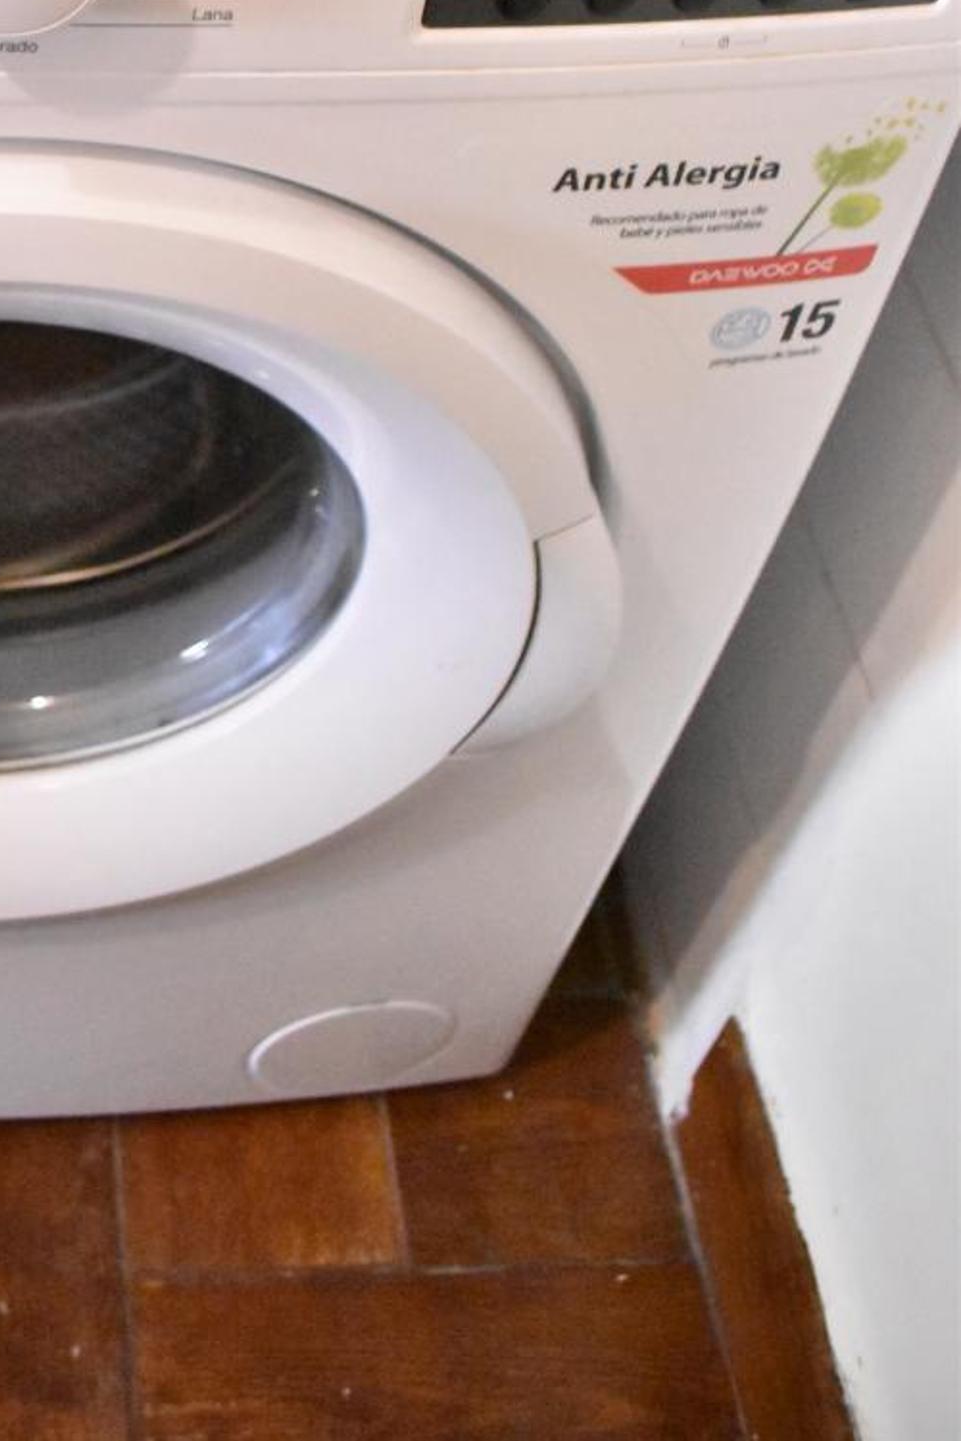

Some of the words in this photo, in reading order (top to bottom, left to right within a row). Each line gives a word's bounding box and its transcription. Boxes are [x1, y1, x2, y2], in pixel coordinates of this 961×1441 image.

[191, 6, 234, 22] Lana
[552, 163, 637, 194] Anti
[643, 155, 782, 192] Alergia
[690, 260, 799, 286] DAEWOO
[779, 298, 843, 344] 15
